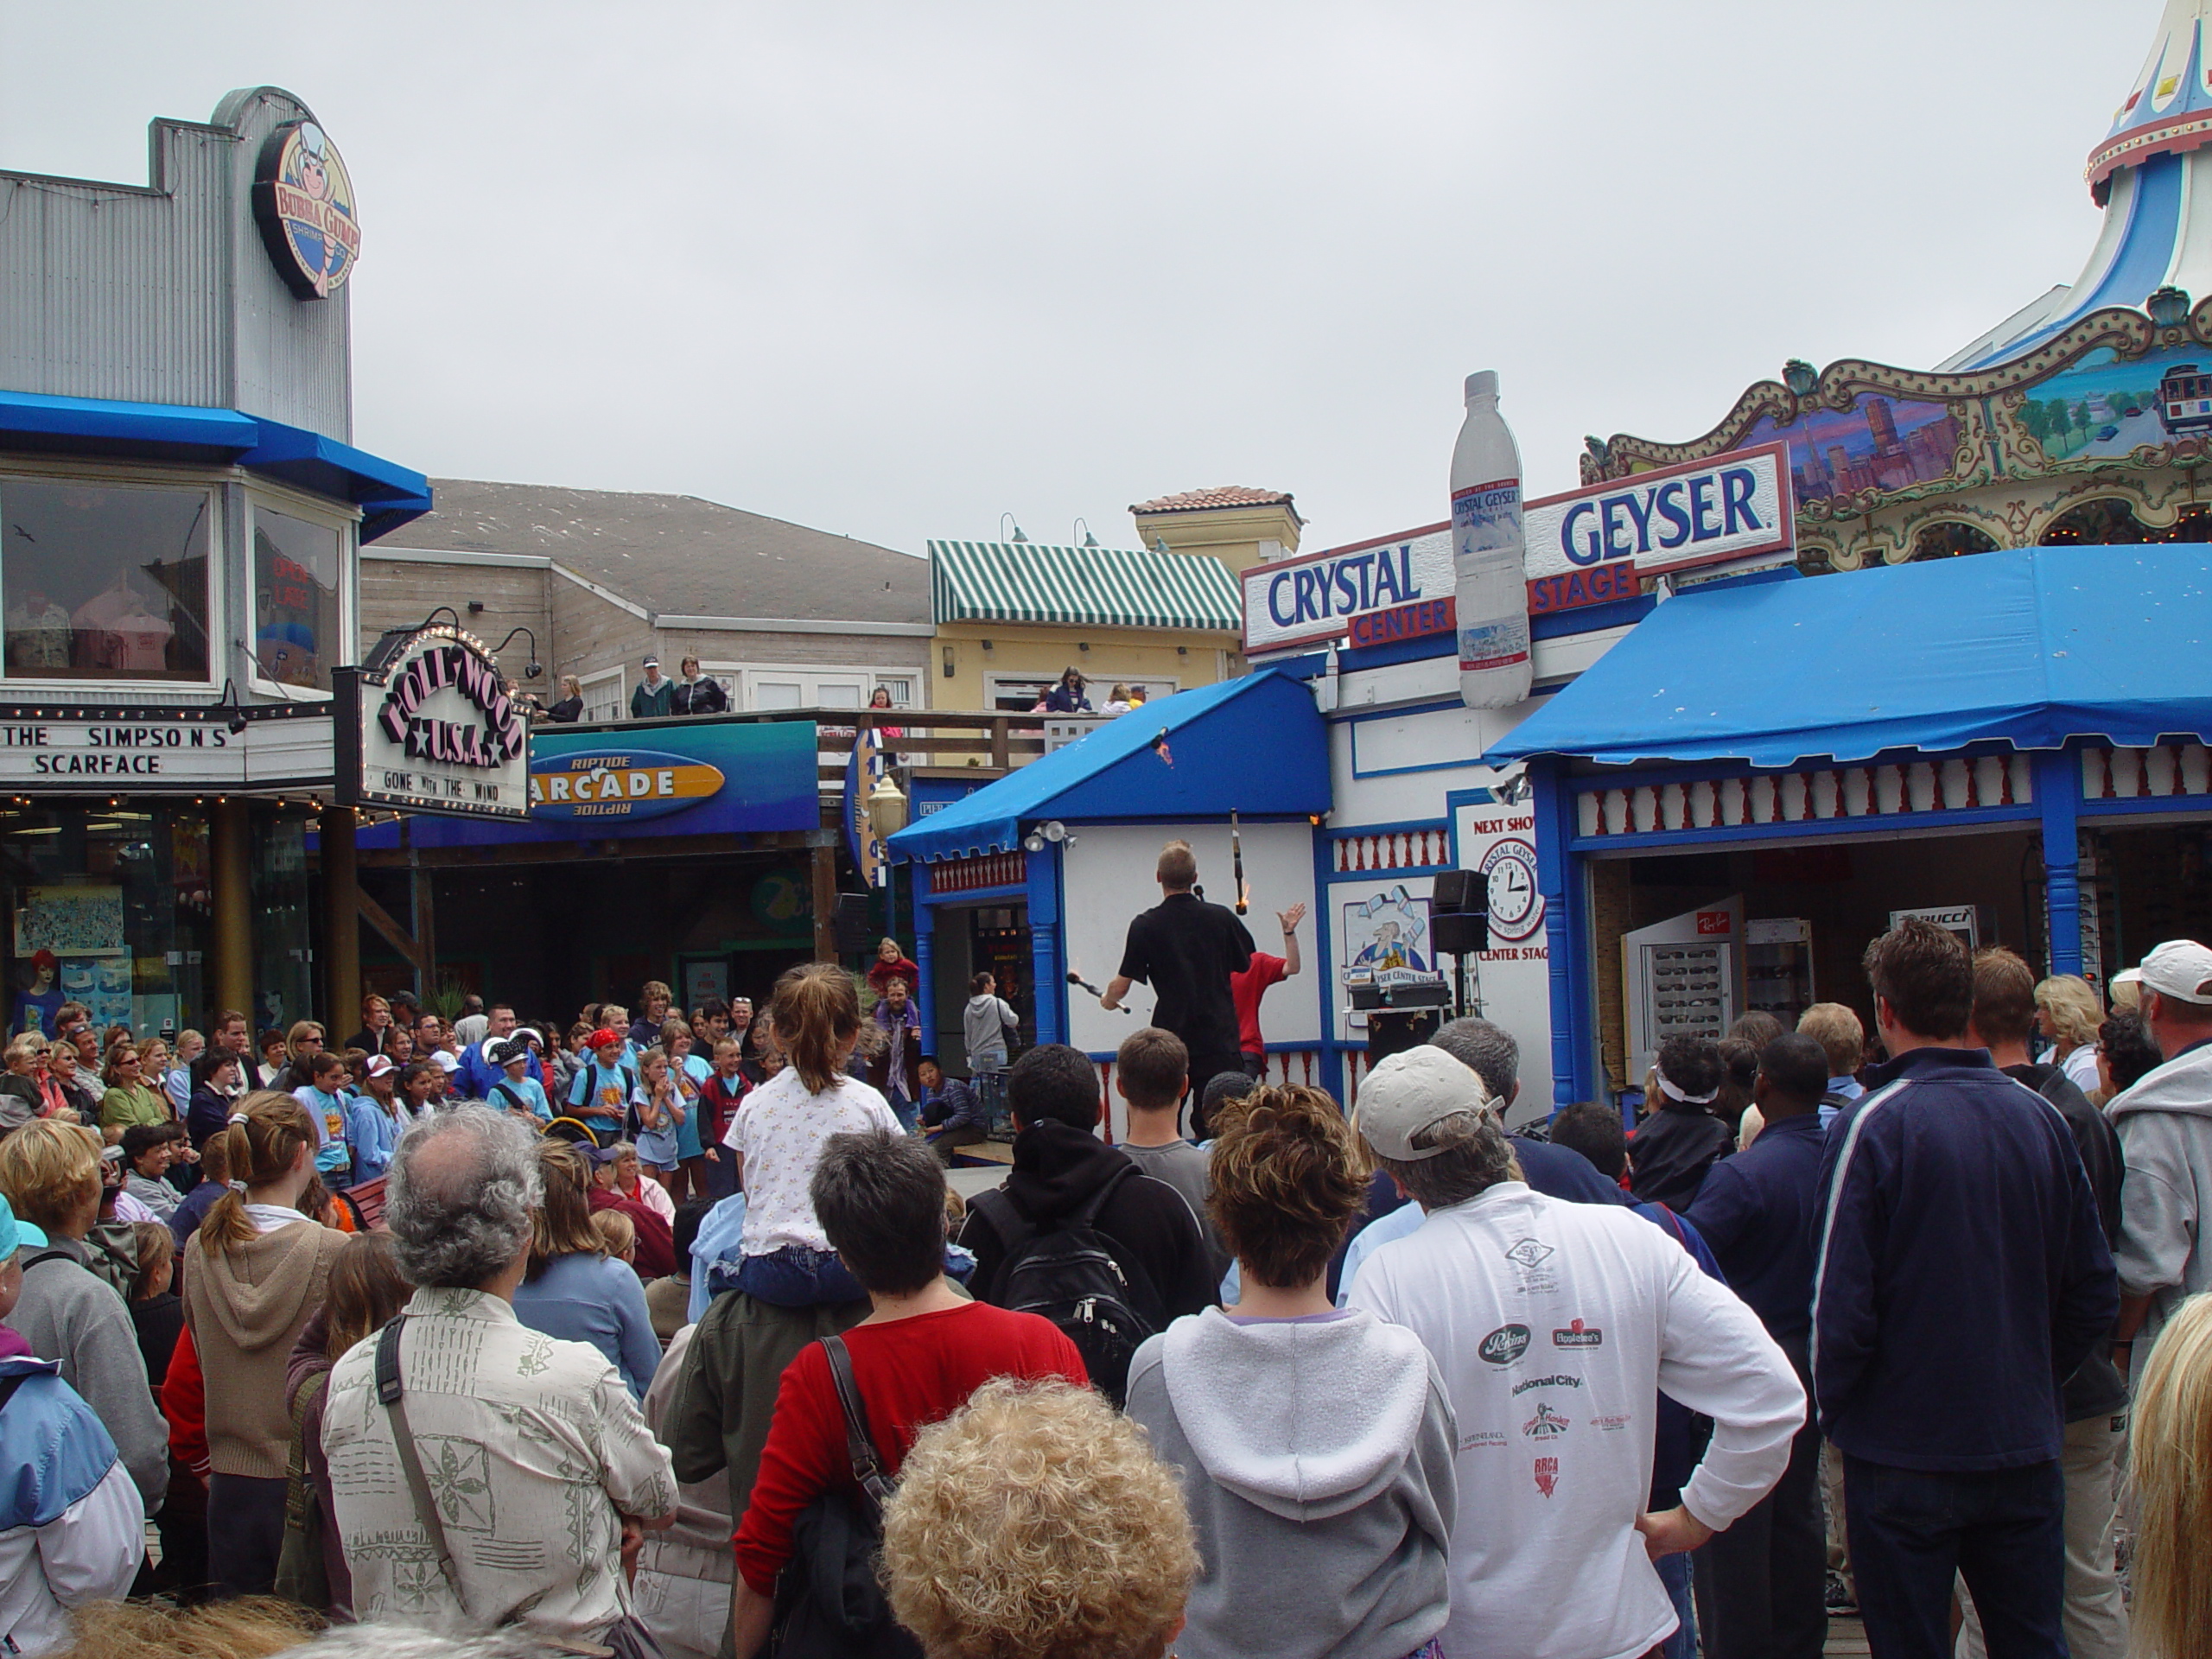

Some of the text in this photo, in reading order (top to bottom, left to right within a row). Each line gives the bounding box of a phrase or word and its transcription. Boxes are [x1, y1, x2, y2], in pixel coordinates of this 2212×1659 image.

[277, 186, 359, 251] BUBBA GUMP
[292, 223, 322, 242] SHRIMP
[1486, 490, 1516, 507] GEYSER
[1268, 544, 1422, 627] CRYSTAL
[1354, 564, 1630, 645] CENTER STAGE
[2, 727, 226, 747] THE SIMPSONS
[429, 718, 489, 767] U.S.A.
[35, 754, 160, 774] SCARFACE
[570, 756, 631, 770] RIPTIDE
[385, 772, 499, 803] GONE WITH THE WIND
[531, 771, 674, 802] ARCADE
[573, 803, 632, 816] RIPTIDE
[923, 804, 944, 814] PIER
[1474, 816, 1535, 836] NEXT SHO
[1484, 843, 1538, 874] RYSTAL GEYSER
[1503, 924, 1525, 935] spring
[1526, 906, 1541, 926] water
[1479, 946, 1548, 961] CENTER STAG
[1393, 970, 1415, 982] CENTER
[1484, 1331, 1527, 1354] Perkins
[1556, 1332, 1599, 1344] Applebee's
[1512, 1375, 1555, 1397] National
[1535, 1457, 1558, 1473] RRCA
